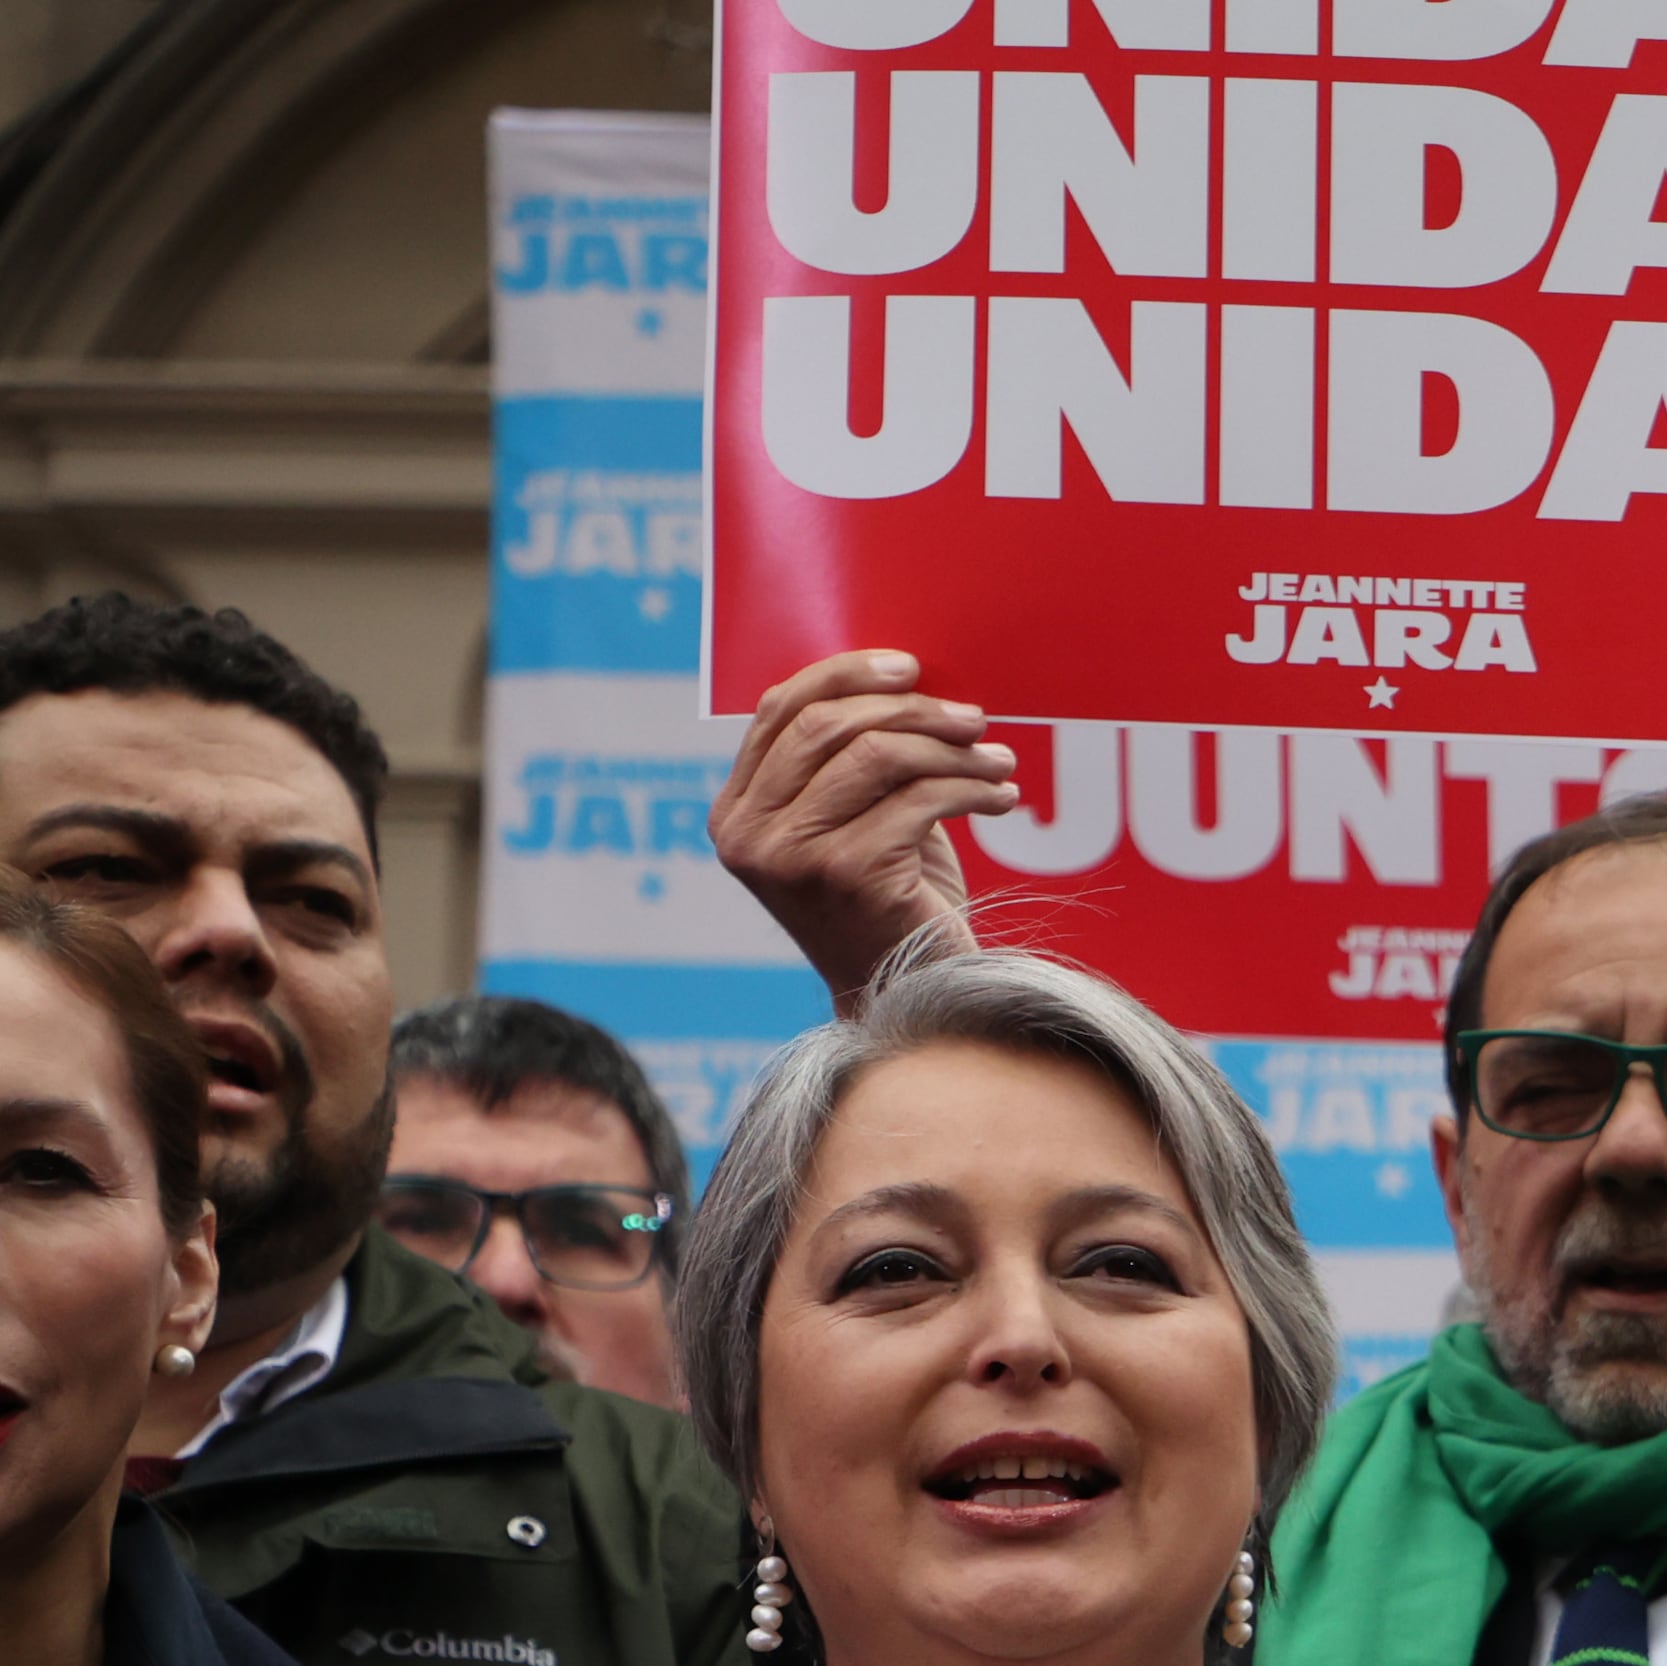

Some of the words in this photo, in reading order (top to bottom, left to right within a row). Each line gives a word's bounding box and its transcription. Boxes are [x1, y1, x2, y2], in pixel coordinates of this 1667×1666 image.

[497, 232, 708, 293] JAR
[504, 513, 703, 576] JAR
[1238, 572, 1526, 610] JEANNETTE
[1225, 604, 1538, 672] JARA
[504, 795, 717, 857] JAR
[1328, 951, 1460, 999] JA
[1266, 1088, 1453, 1150] JAR
